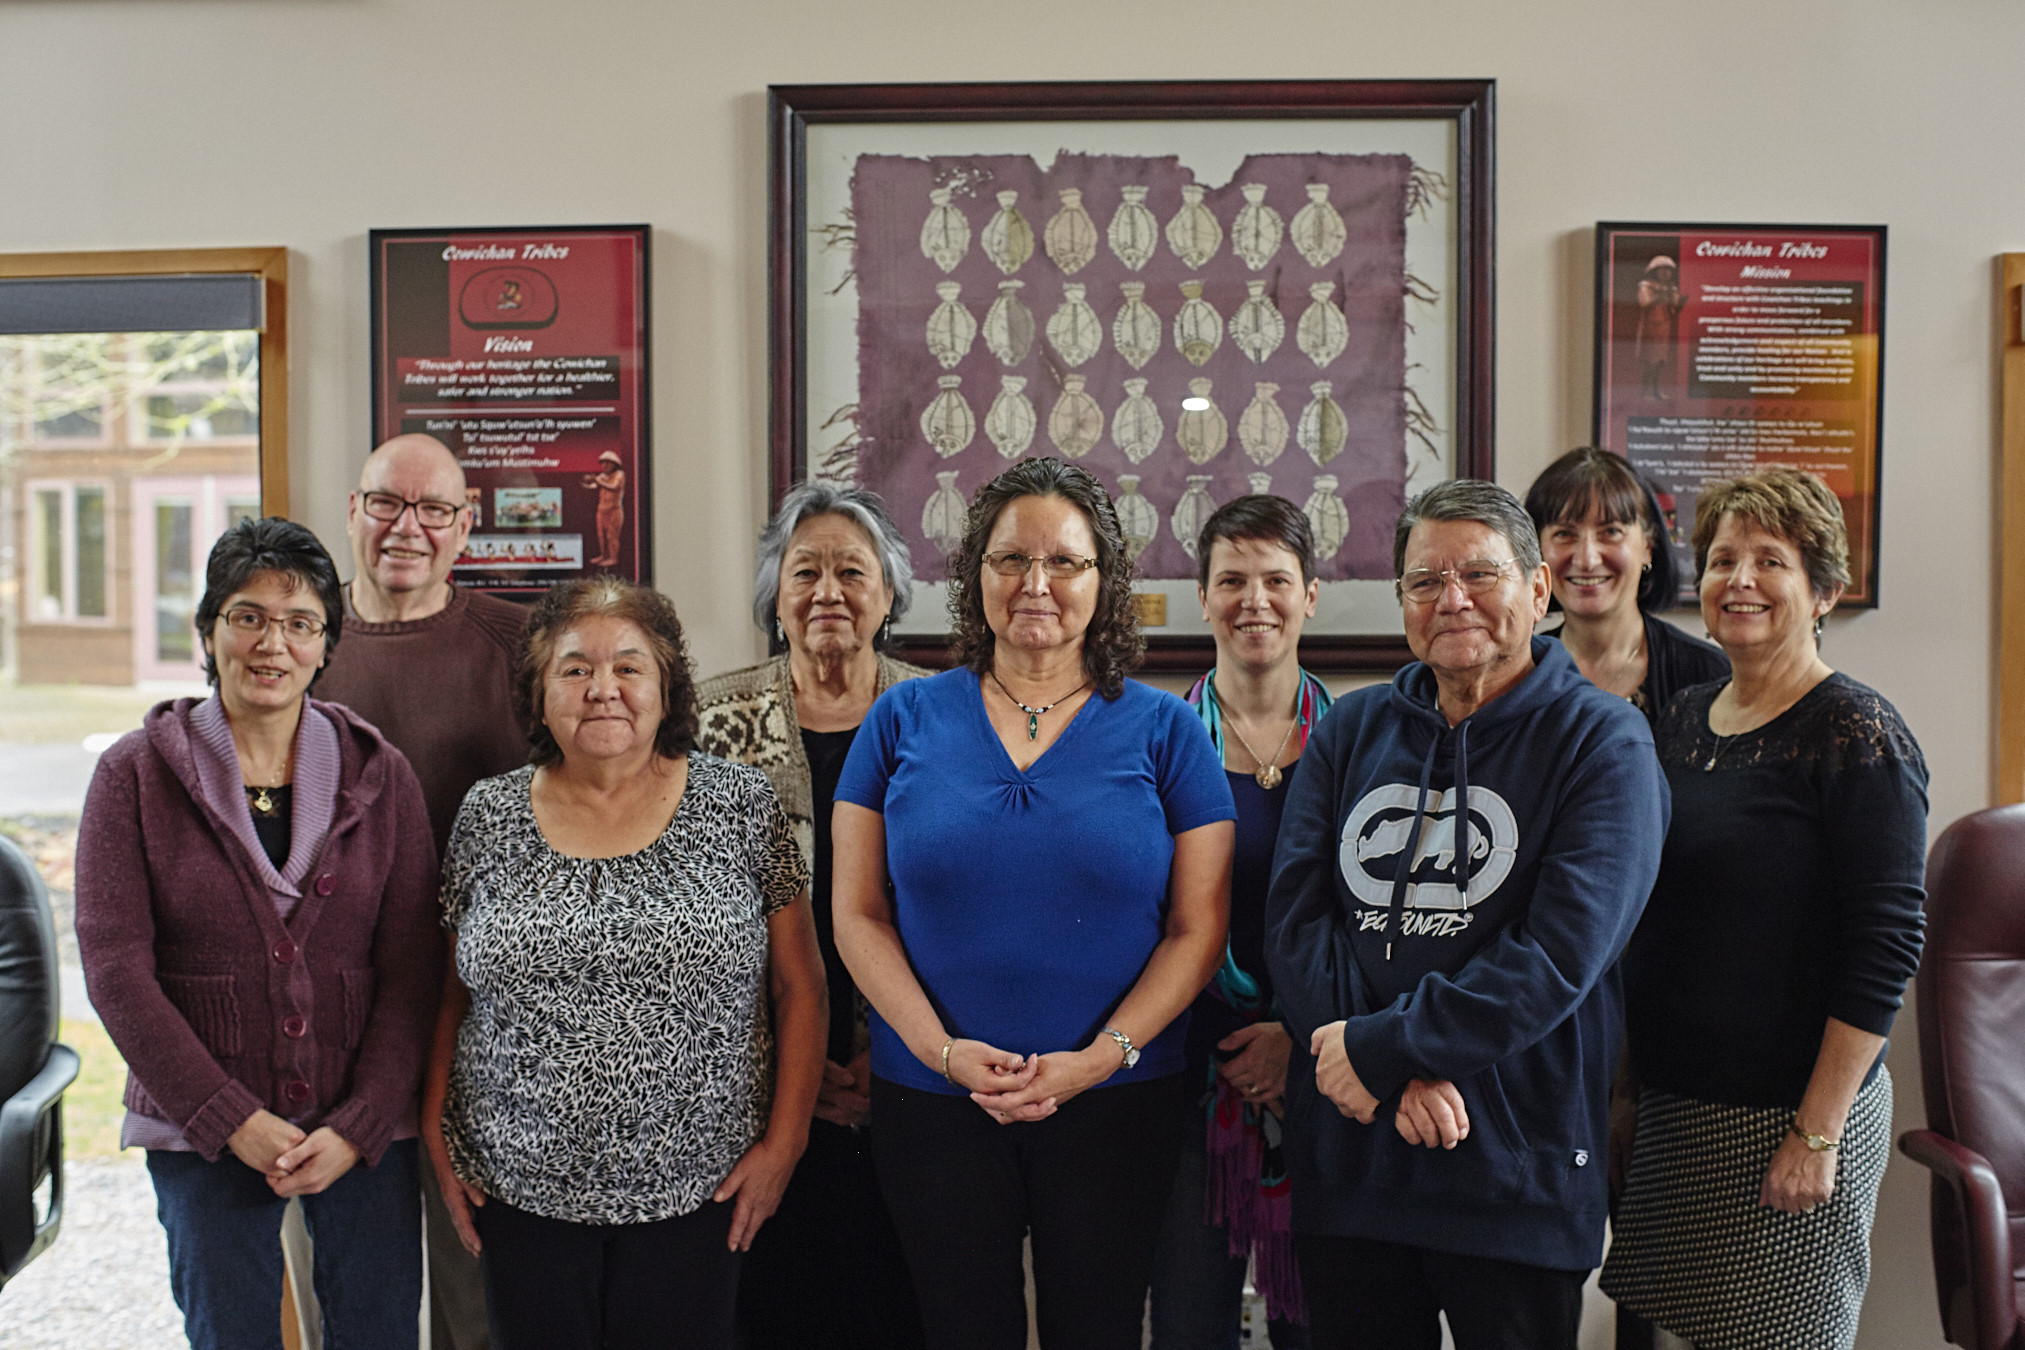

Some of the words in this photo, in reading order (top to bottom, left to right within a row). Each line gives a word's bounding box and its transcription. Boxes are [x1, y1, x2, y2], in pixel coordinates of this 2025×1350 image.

[441, 243, 516, 261] Cowichan
[521, 243, 570, 260] Tribes
[1696, 241, 1773, 258] Cowichan
[1778, 241, 1829, 258] Tribes
[1739, 264, 1792, 279] Mission
[484, 336, 534, 353] Vision
[532, 357, 551, 369] the
[553, 356, 607, 370] Cowichan
[438, 373, 459, 384] will
[555, 374, 564, 383] a
[466, 386, 487, 397] and
